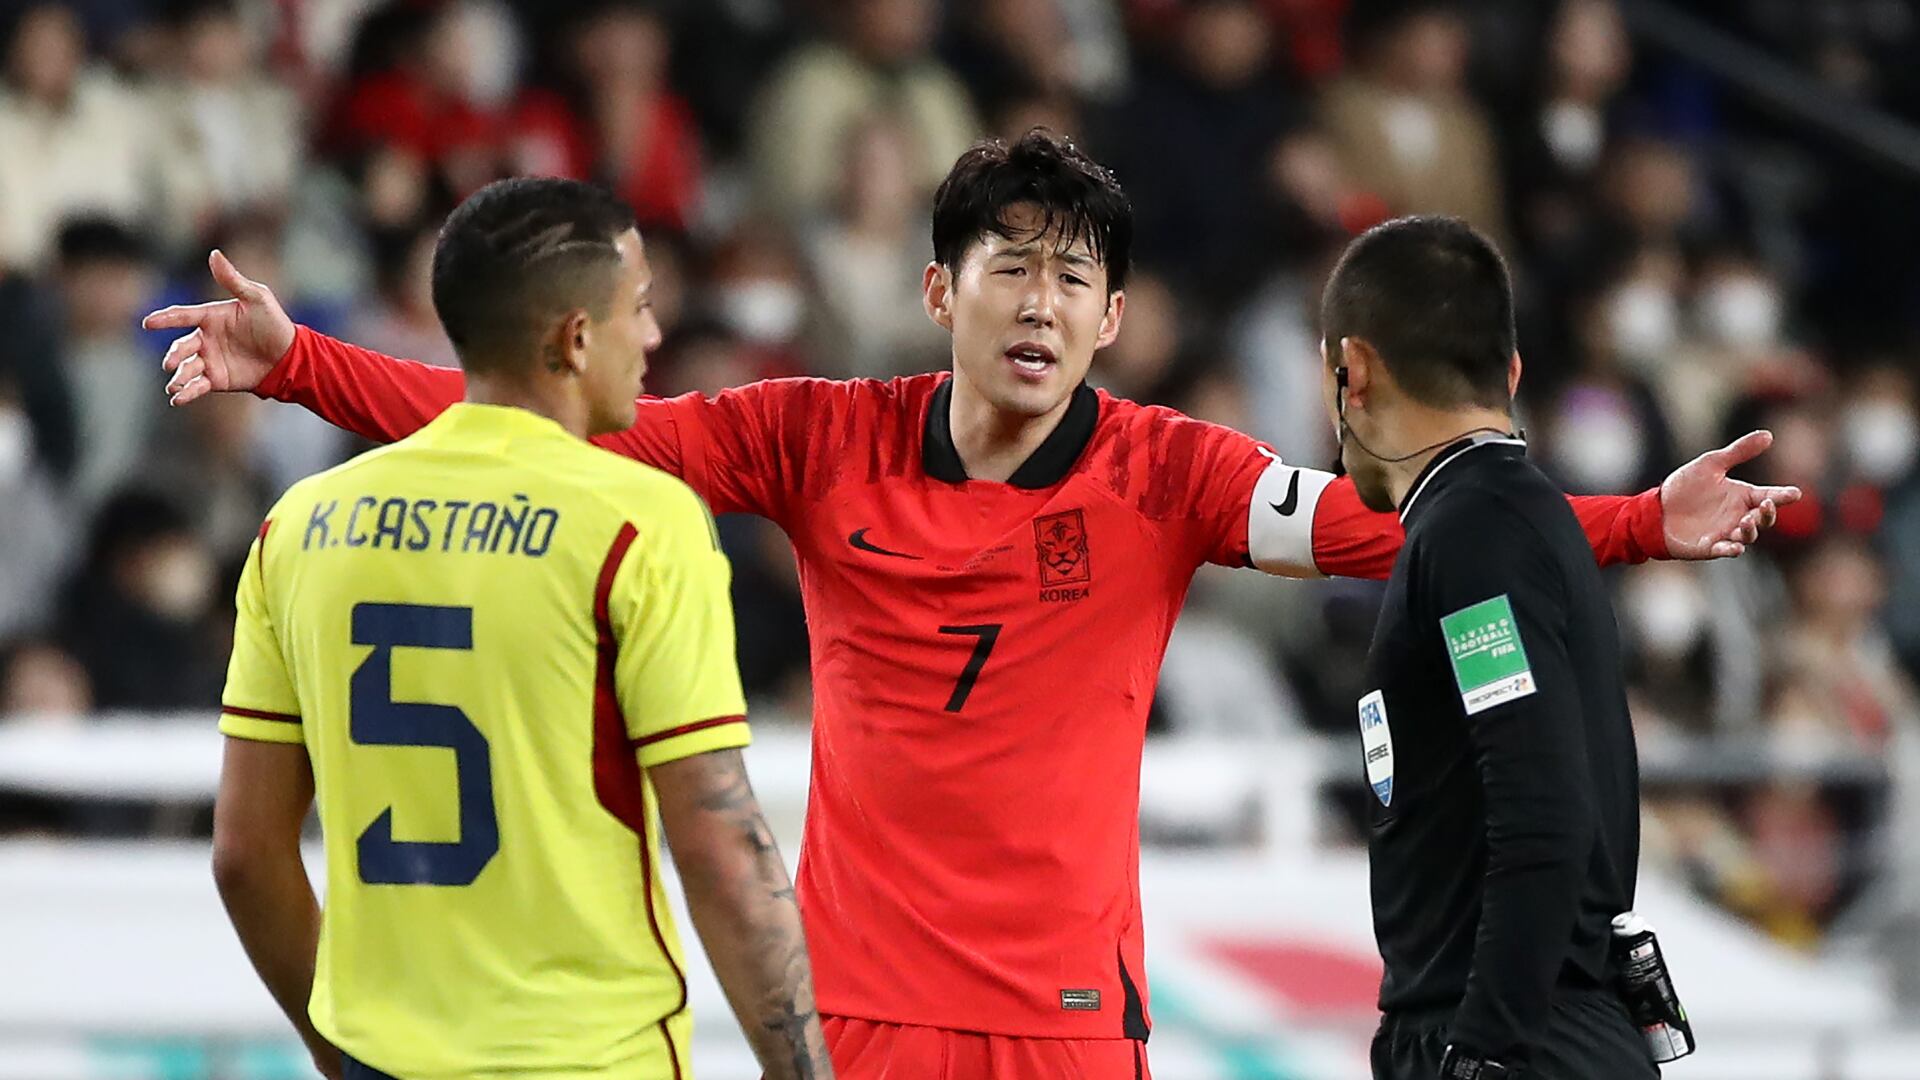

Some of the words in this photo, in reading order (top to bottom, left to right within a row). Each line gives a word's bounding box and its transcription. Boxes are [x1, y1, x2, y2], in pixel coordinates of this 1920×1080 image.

[302, 493, 560, 558] K.CASTAÑO
[1039, 587, 1090, 602] KOREA
[1451, 618, 1509, 645] LIVING
[1453, 627, 1512, 654] FOOTBALL
[1490, 642, 1517, 658] FIFA
[938, 623, 1003, 712] 7
[1361, 701, 1382, 733] FIFA
[350, 602, 499, 885] 5
